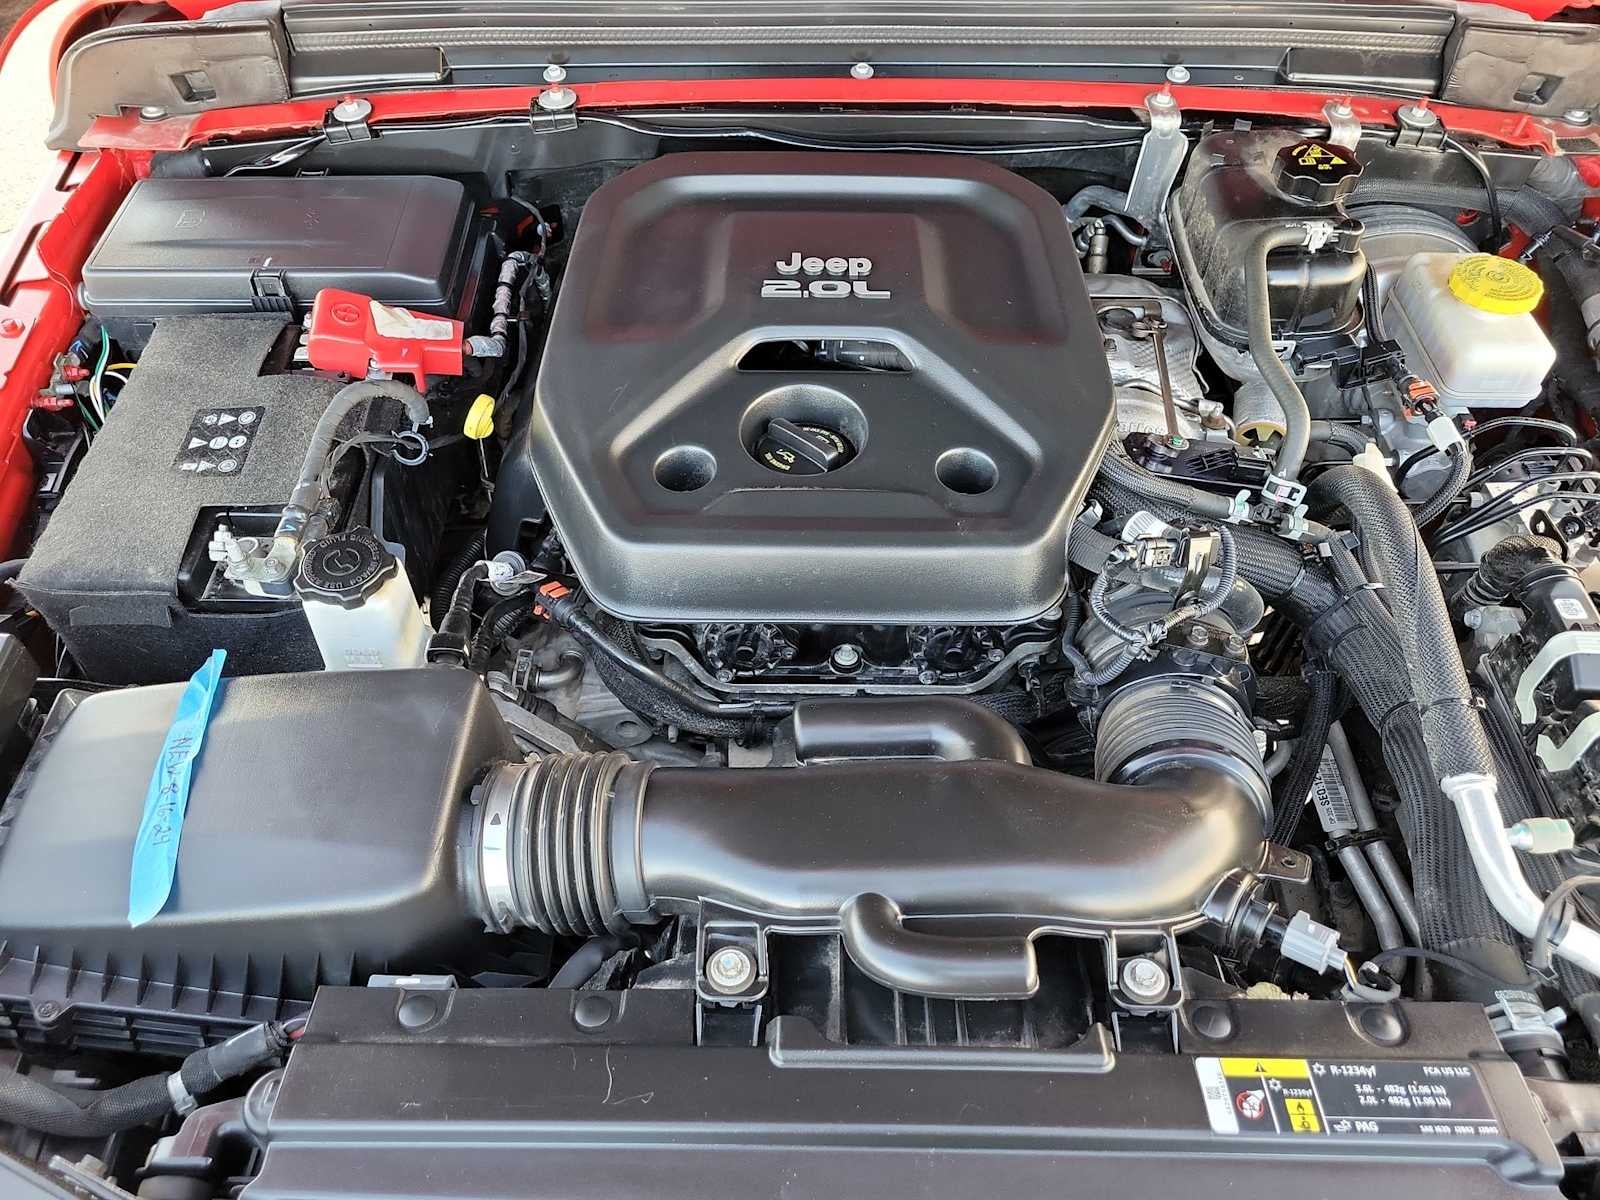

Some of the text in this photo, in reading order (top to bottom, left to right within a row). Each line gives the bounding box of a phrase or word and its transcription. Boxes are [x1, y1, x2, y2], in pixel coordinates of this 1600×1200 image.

[776, 252, 872, 279] Jeep
[761, 279, 891, 299] 2.0L
[319, 534, 346, 548] FLUID
[350, 534, 380, 560] STEERING
[1423, 1066, 1471, 1077] FCA US LLC
[1358, 1095, 1378, 1106] 2.0L
[1354, 1121, 1379, 1133] PAG
